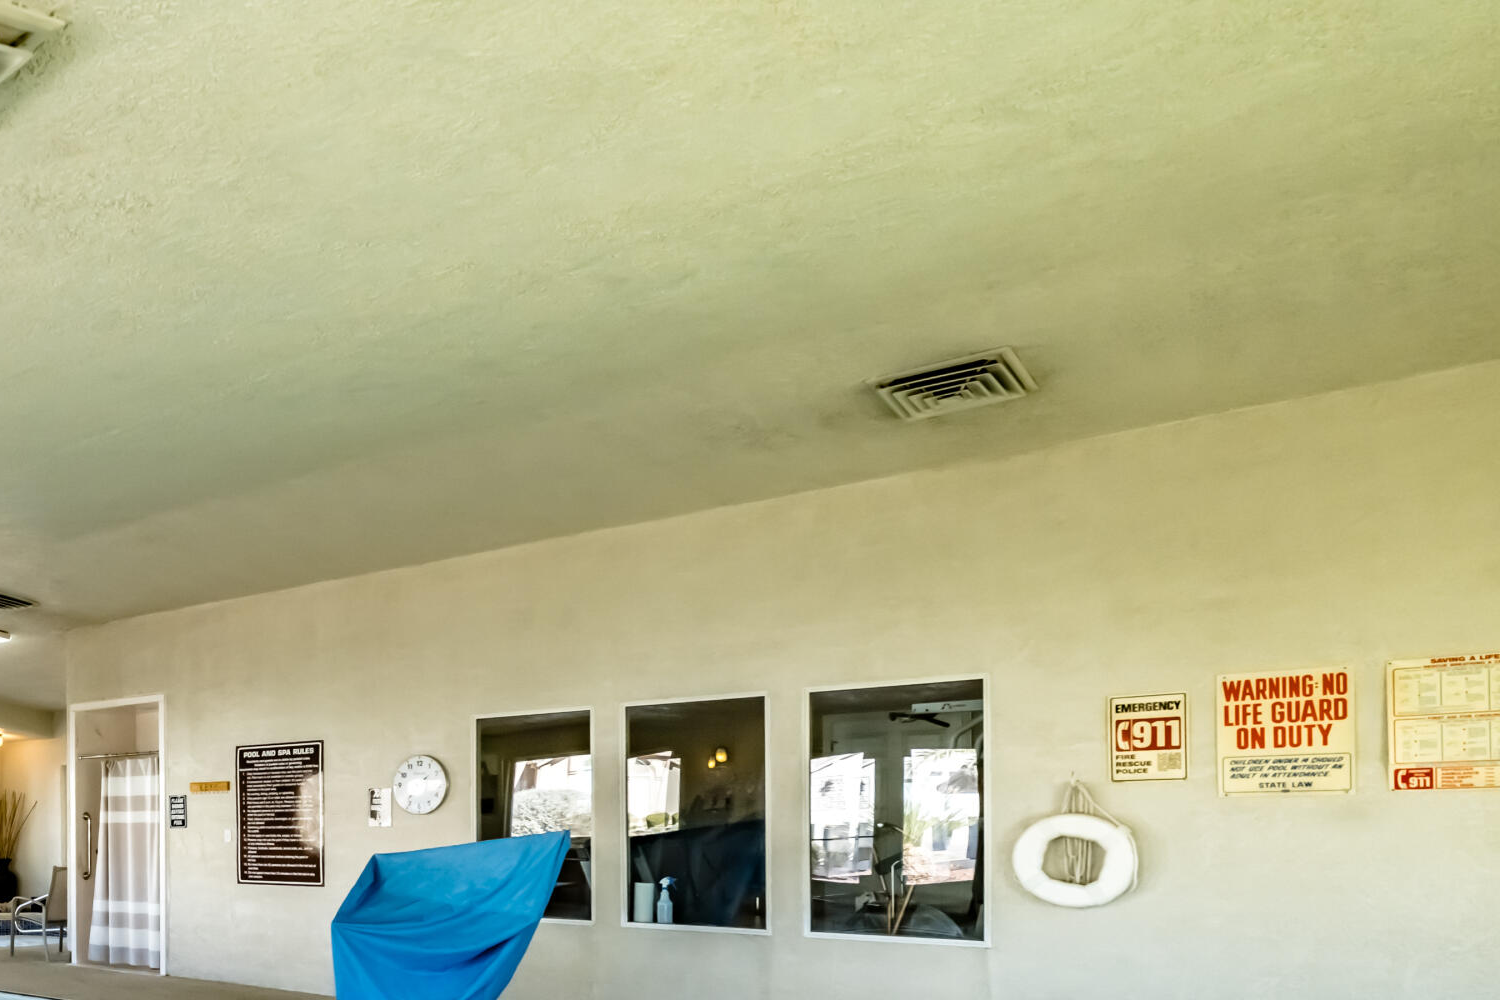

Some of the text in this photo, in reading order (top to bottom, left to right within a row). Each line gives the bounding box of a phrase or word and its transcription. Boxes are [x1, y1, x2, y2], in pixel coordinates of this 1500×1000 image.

[1322, 672, 1348, 696] NO
[1115, 700, 1181, 713] EMERGENCY
[1223, 697, 1348, 727] LIFE GUARD
[1132, 719, 1180, 749] 911
[1236, 723, 1333, 750] ON DUTY
[292, 747, 315, 755] RULES
[1229, 758, 1272, 766] CHILDREN
[1409, 776, 1431, 788] 911
